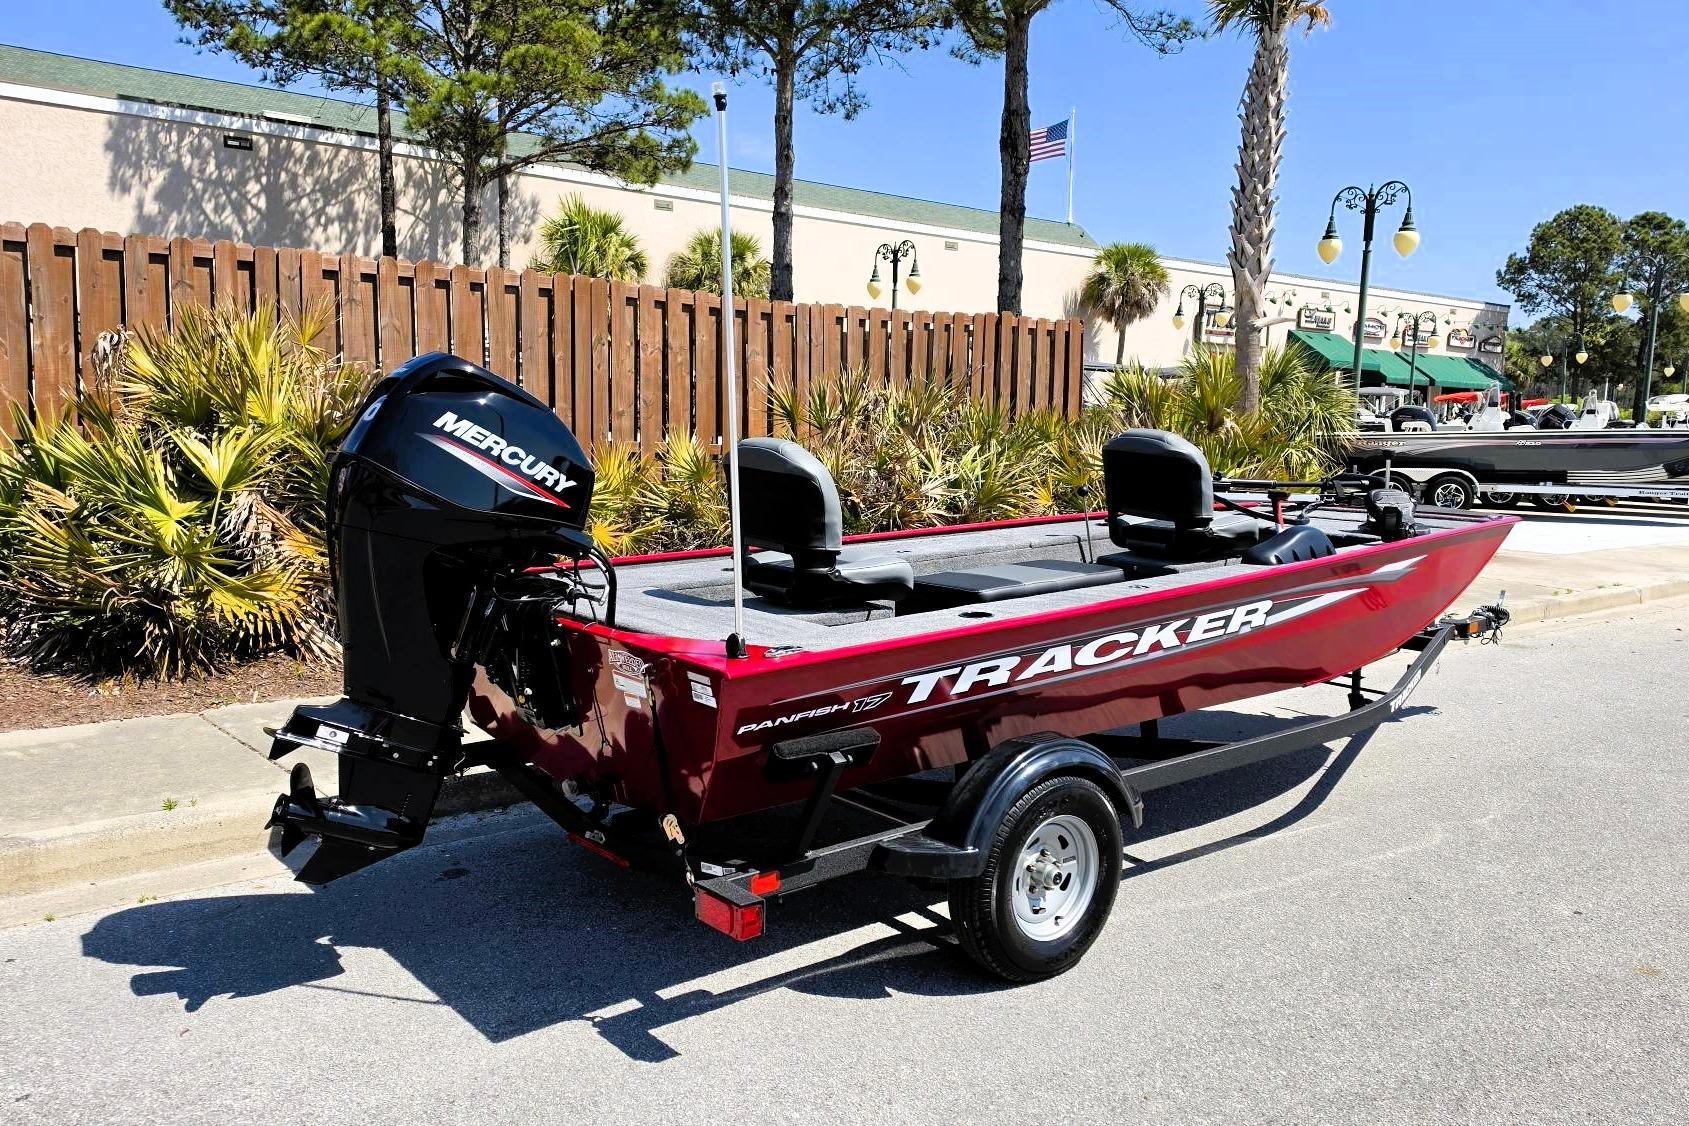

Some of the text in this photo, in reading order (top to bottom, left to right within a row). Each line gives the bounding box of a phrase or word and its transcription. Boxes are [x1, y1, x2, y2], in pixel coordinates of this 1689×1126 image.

[432, 411, 577, 492] MERCURY
[902, 599, 1274, 703] TRACKER
[737, 691, 893, 735] PANFISH 17
